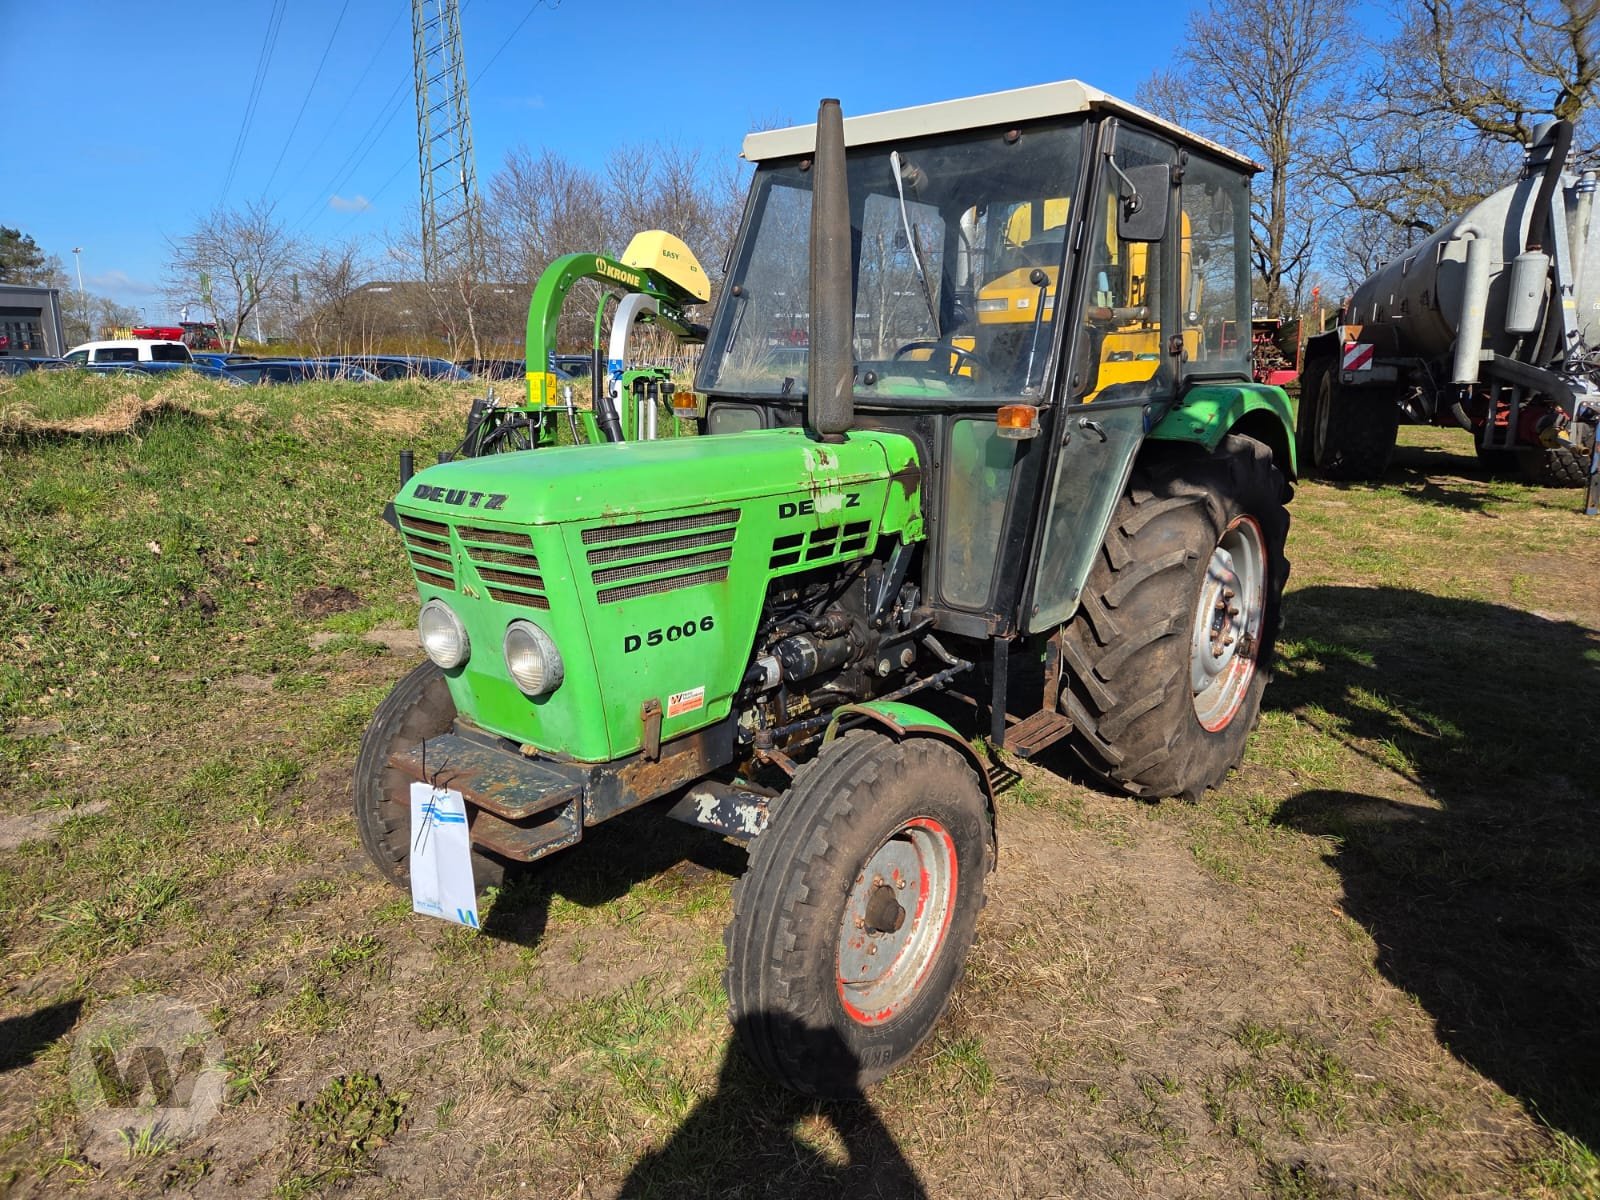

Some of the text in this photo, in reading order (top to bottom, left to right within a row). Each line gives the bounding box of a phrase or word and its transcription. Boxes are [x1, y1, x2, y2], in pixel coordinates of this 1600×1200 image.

[662, 249, 680, 260] EASY
[607, 265, 640, 287] KRONE
[413, 484, 508, 510] DEUTZ
[779, 493, 860, 519] DEZ
